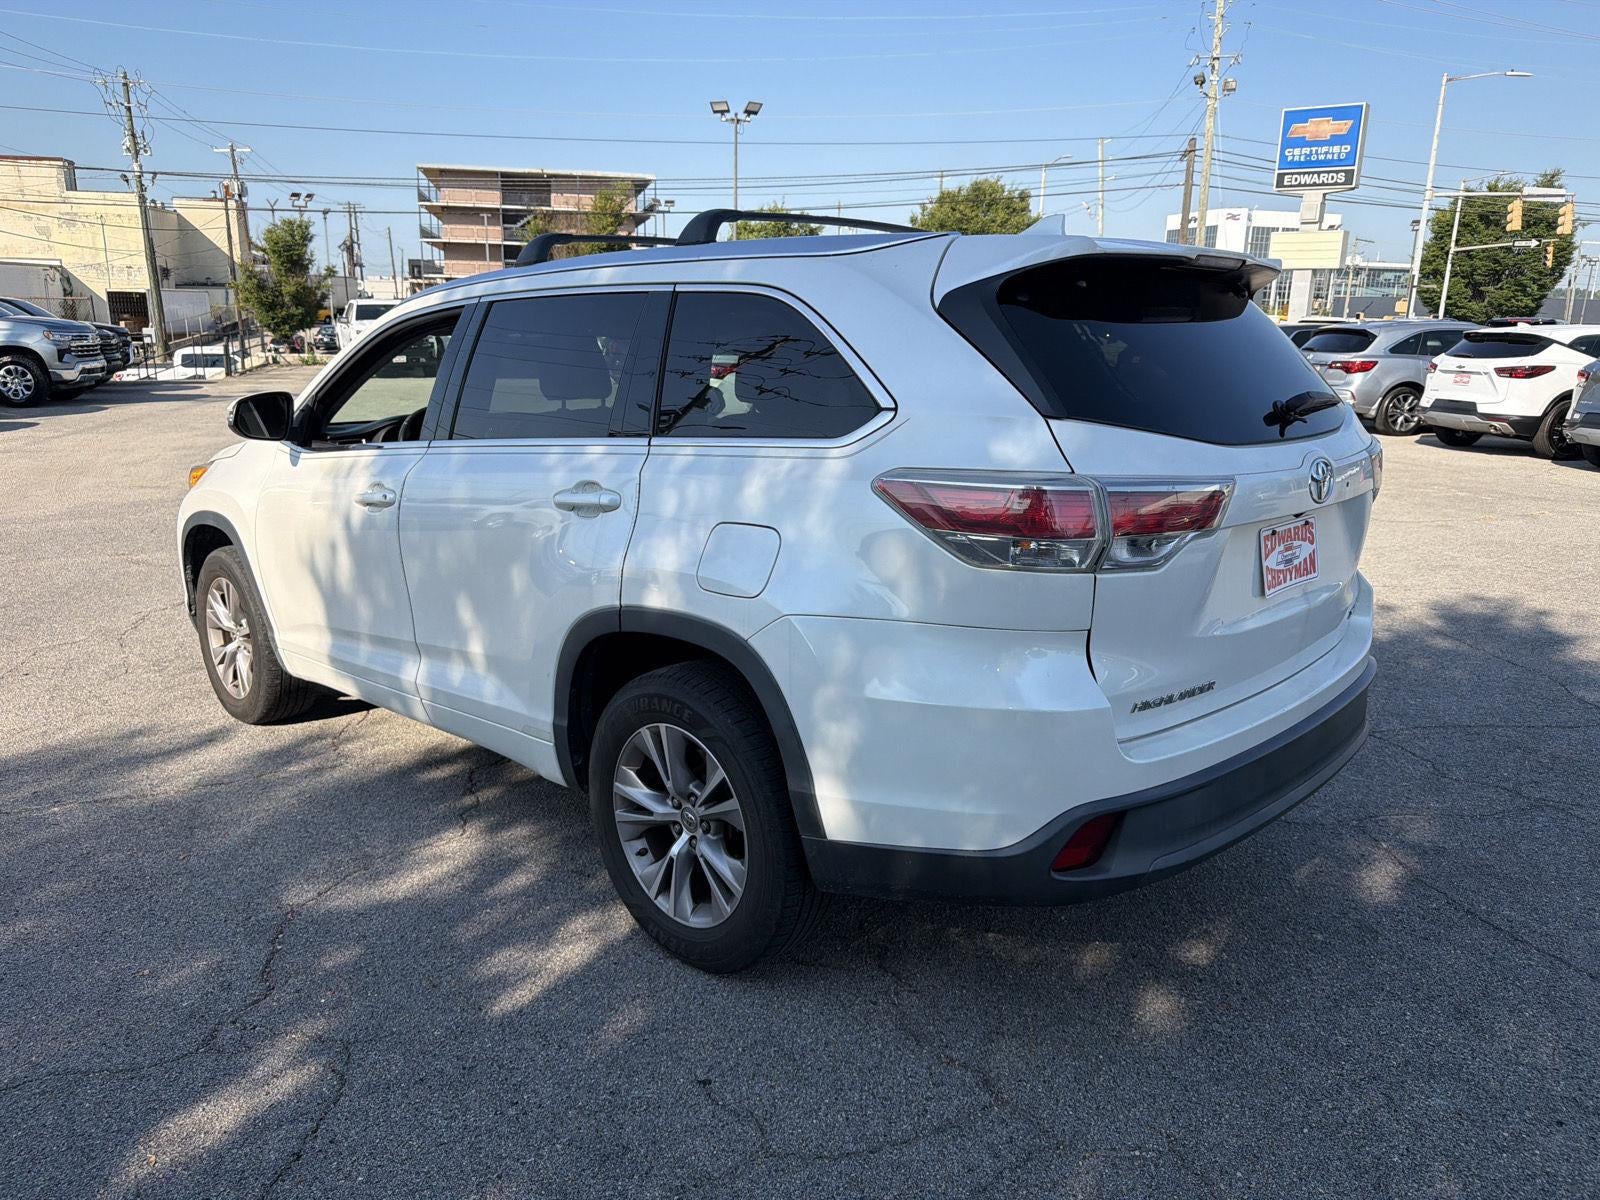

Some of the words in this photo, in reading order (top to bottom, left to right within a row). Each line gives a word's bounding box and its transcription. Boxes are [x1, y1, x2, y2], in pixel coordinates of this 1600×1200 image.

[1285, 145, 1351, 156] CERTIFIED
[1288, 153, 1346, 162] PRE-OWNED
[1283, 172, 1346, 186] EDWARDS
[1263, 522, 1315, 561] EDWARDS
[1266, 548, 1316, 591] CHEVYMAN
